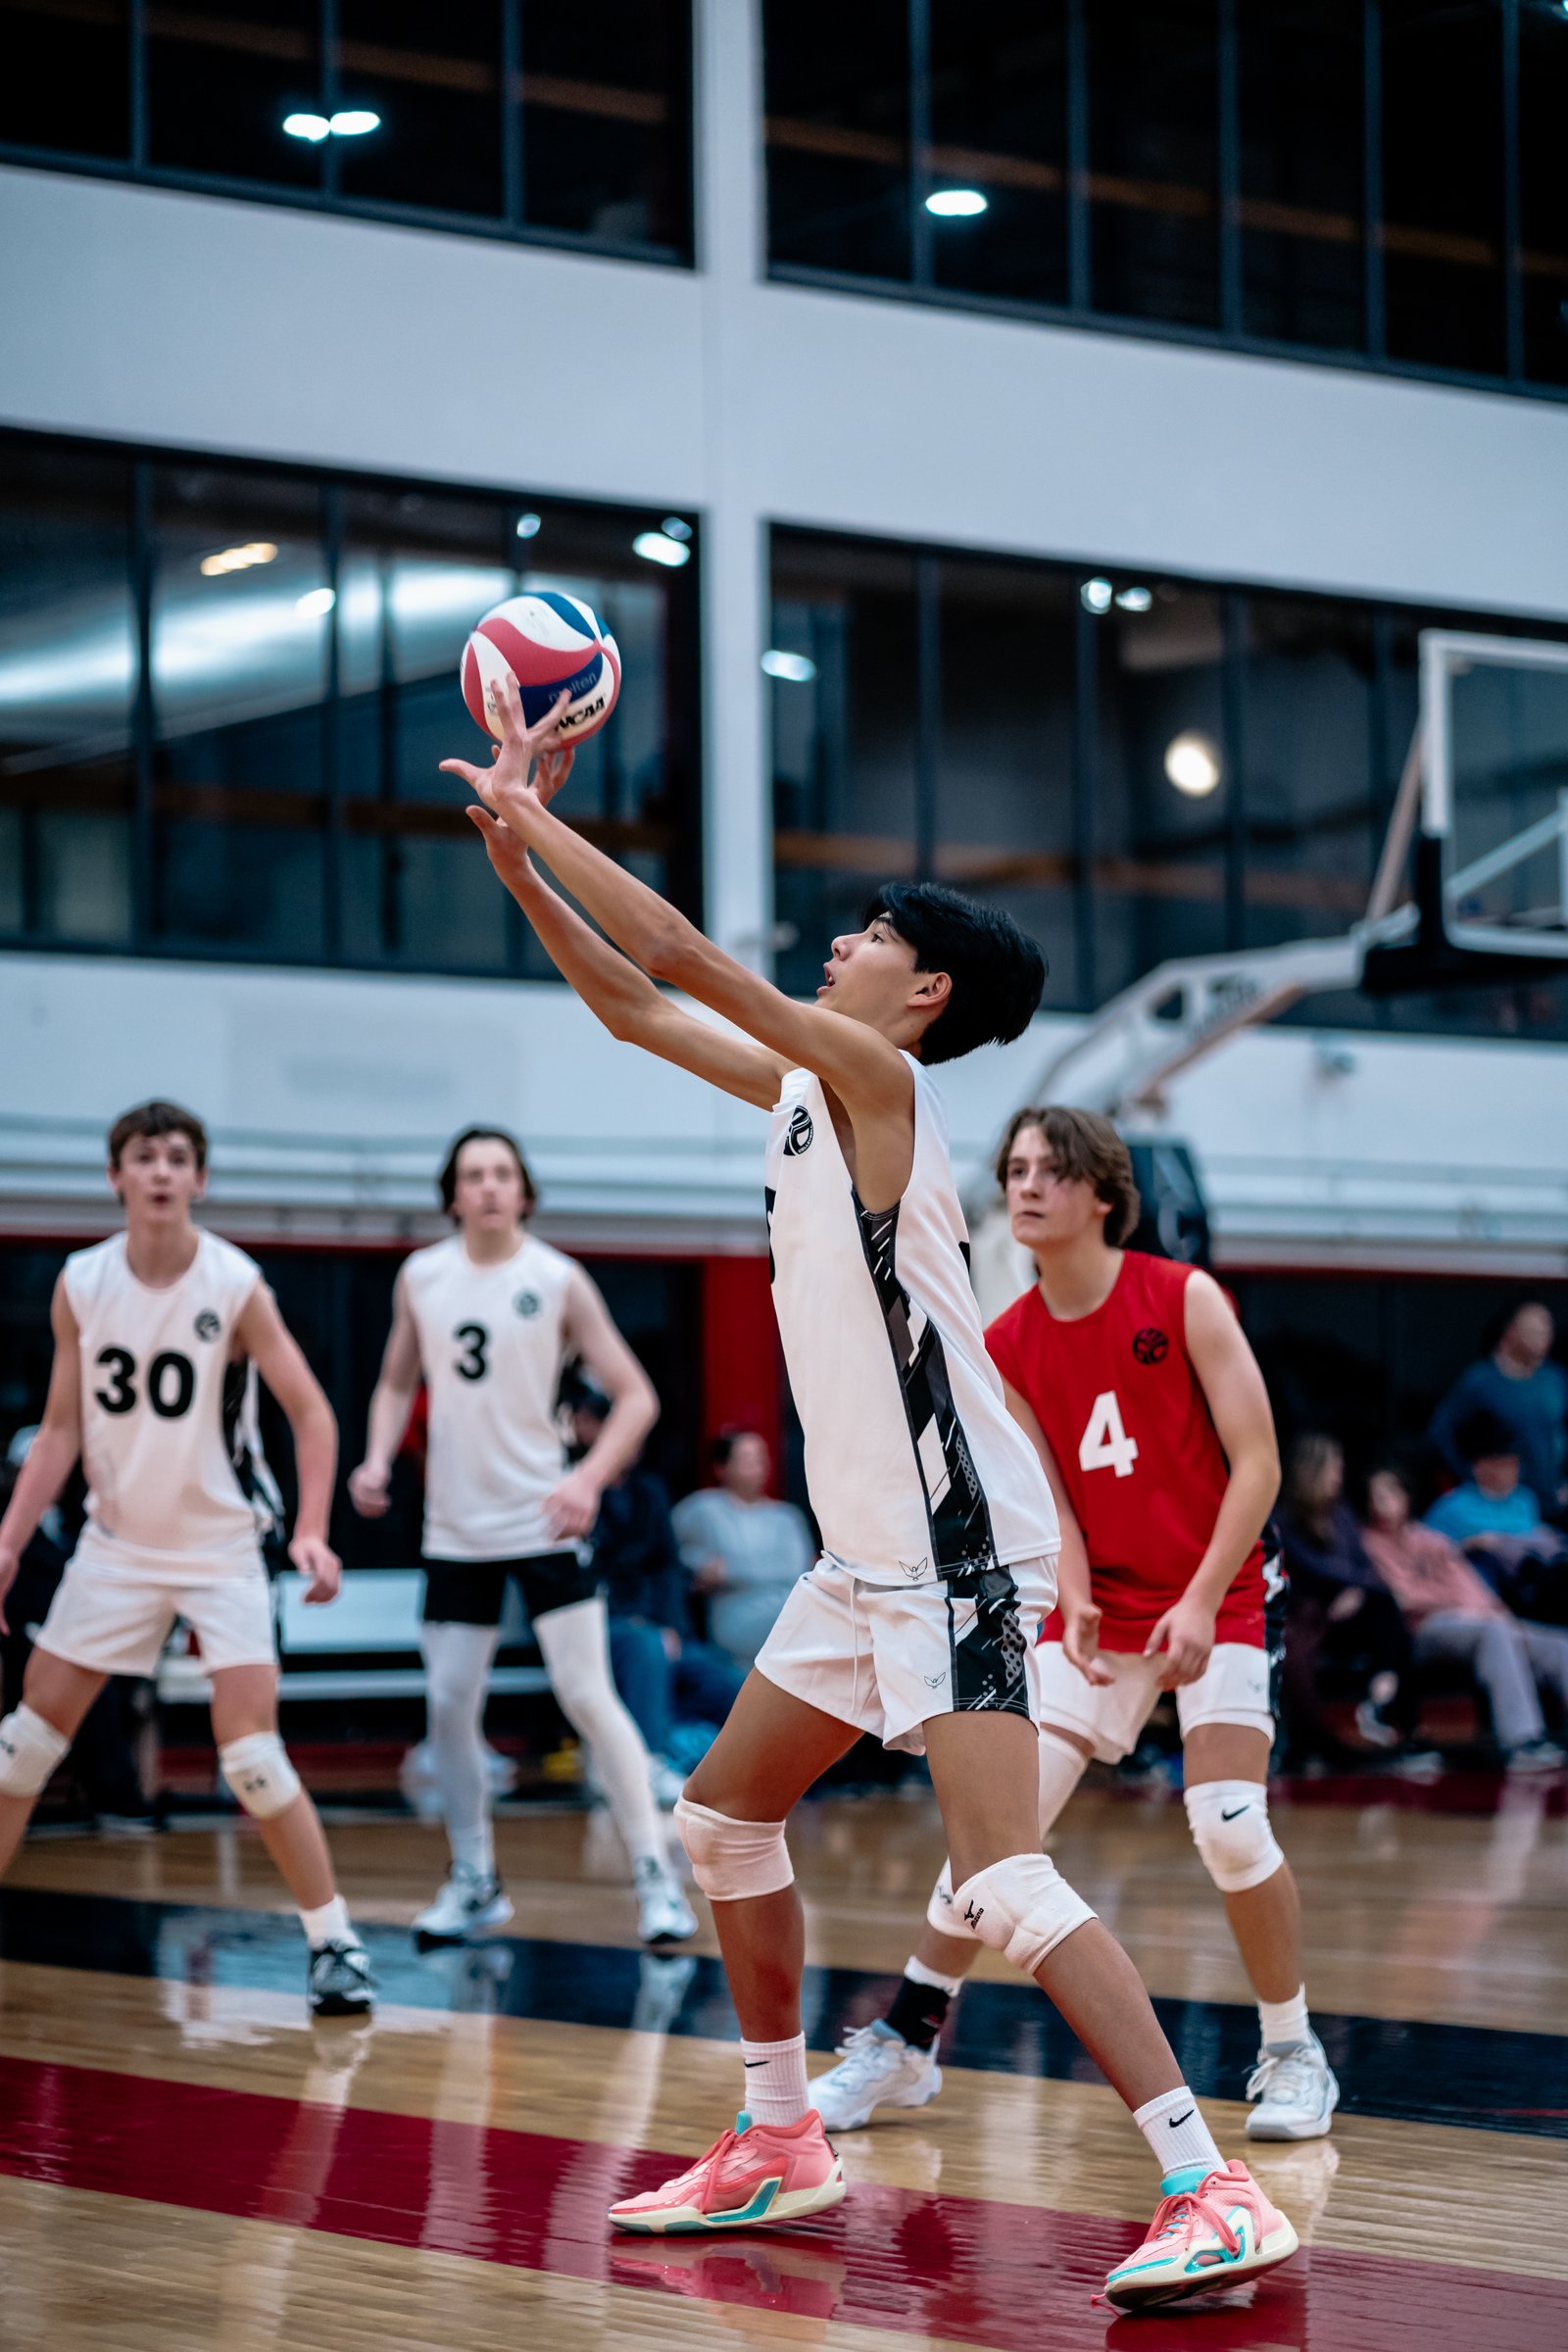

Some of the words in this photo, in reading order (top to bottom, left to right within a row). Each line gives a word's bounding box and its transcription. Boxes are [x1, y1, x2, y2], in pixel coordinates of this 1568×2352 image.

[549, 673, 597, 704] mlten
[555, 697, 605, 732] NCAA
[96, 1346, 195, 1418] 30
[455, 1321, 490, 1383] 3
[1079, 1390, 1139, 1478] 4
